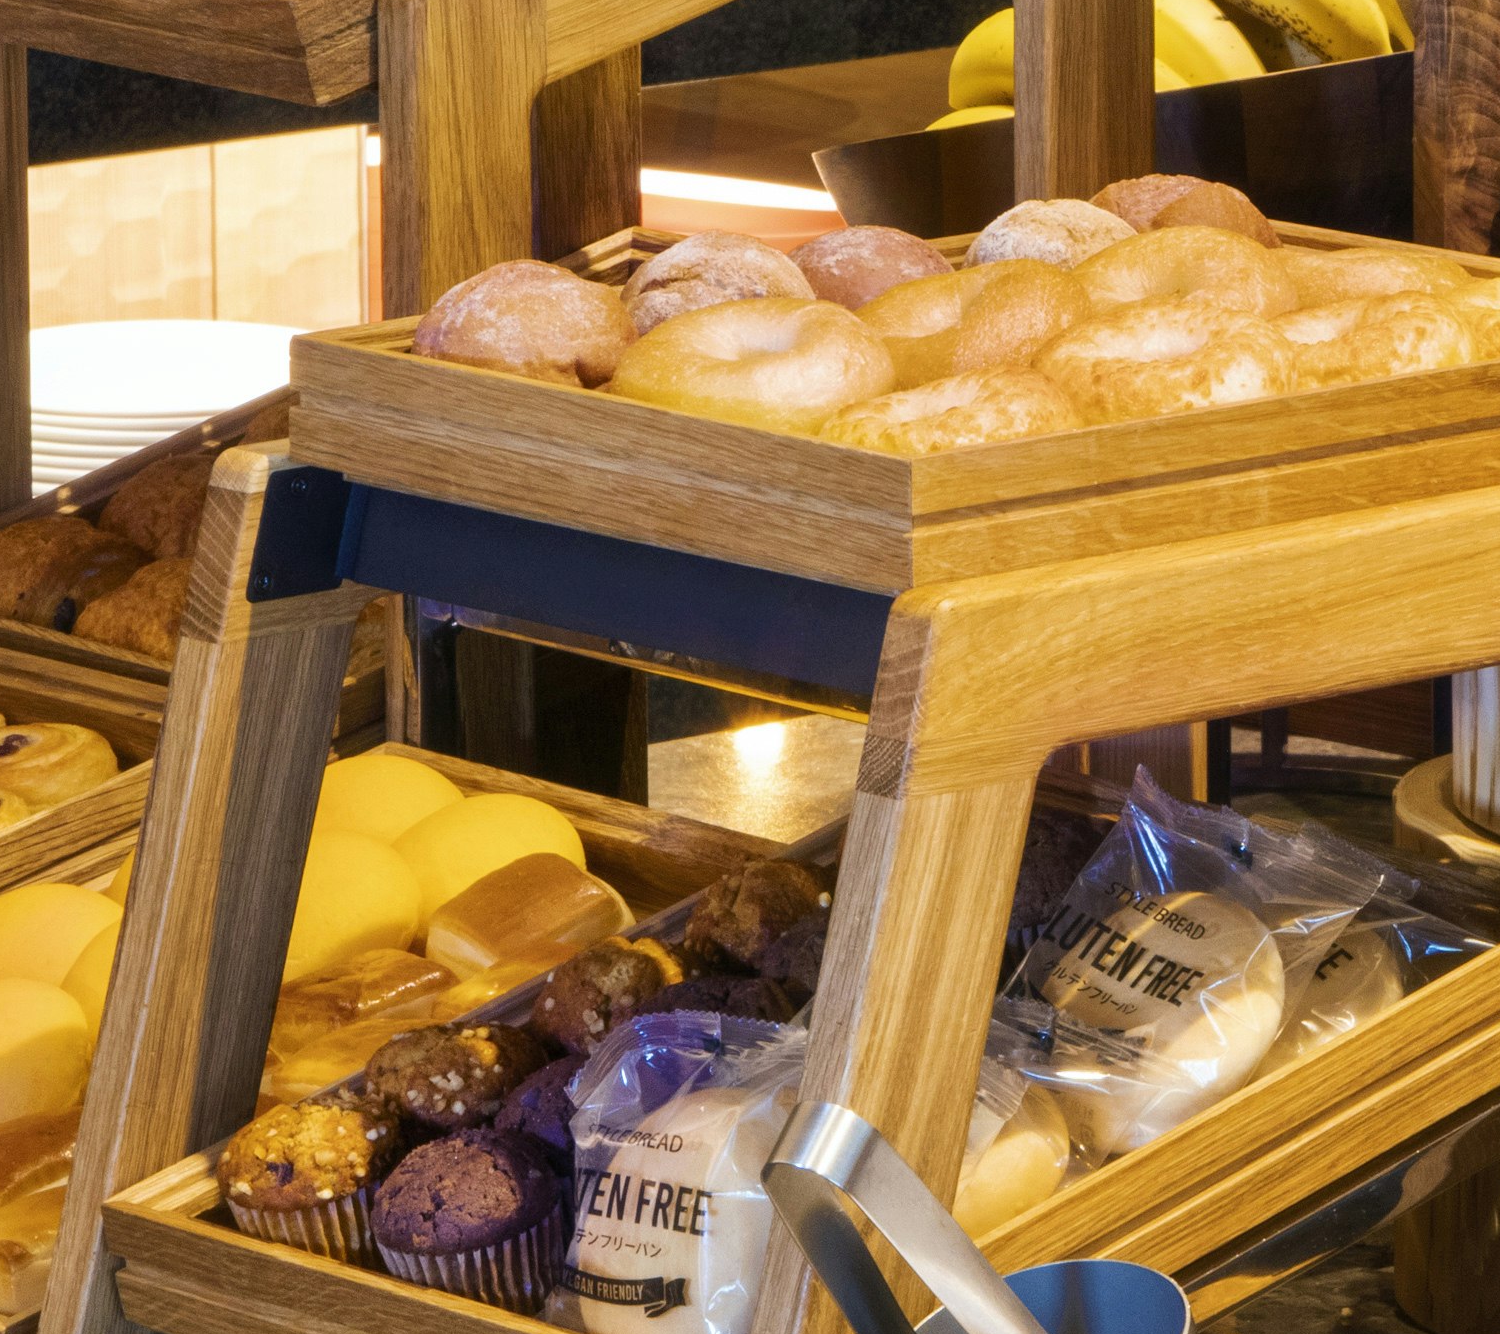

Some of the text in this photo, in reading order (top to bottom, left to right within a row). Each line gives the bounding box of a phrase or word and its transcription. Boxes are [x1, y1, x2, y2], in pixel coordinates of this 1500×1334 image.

[1105, 881, 1206, 941] STYLE BREAD
[1130, 954, 1205, 1008] FREE
[627, 1131, 683, 1153] BREAD
[634, 1178, 713, 1237] FREE
[596, 1281, 644, 1301] FRIENDLY
